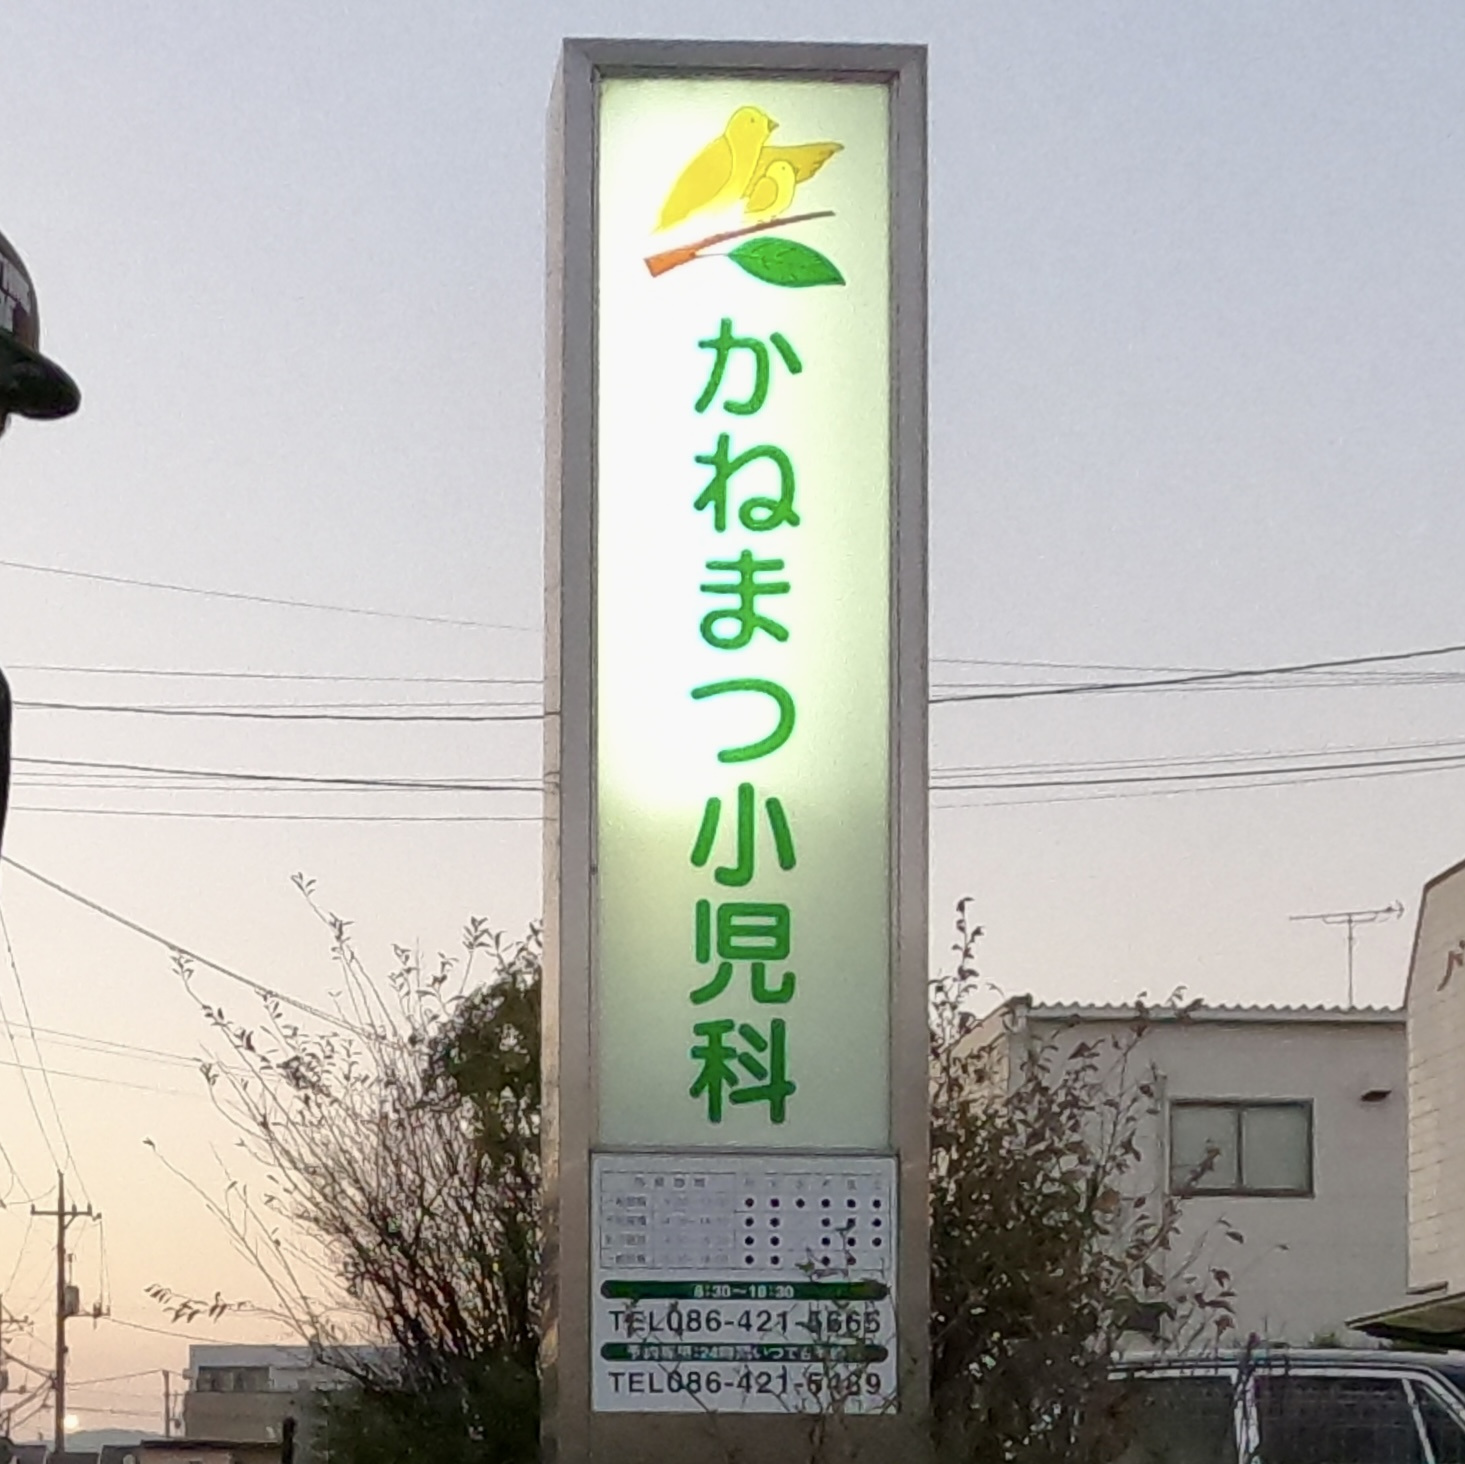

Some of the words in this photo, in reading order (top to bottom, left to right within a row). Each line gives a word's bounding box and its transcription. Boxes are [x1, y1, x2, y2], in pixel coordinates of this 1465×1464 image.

[690, 317, 803, 1124] かねまつ小児科
